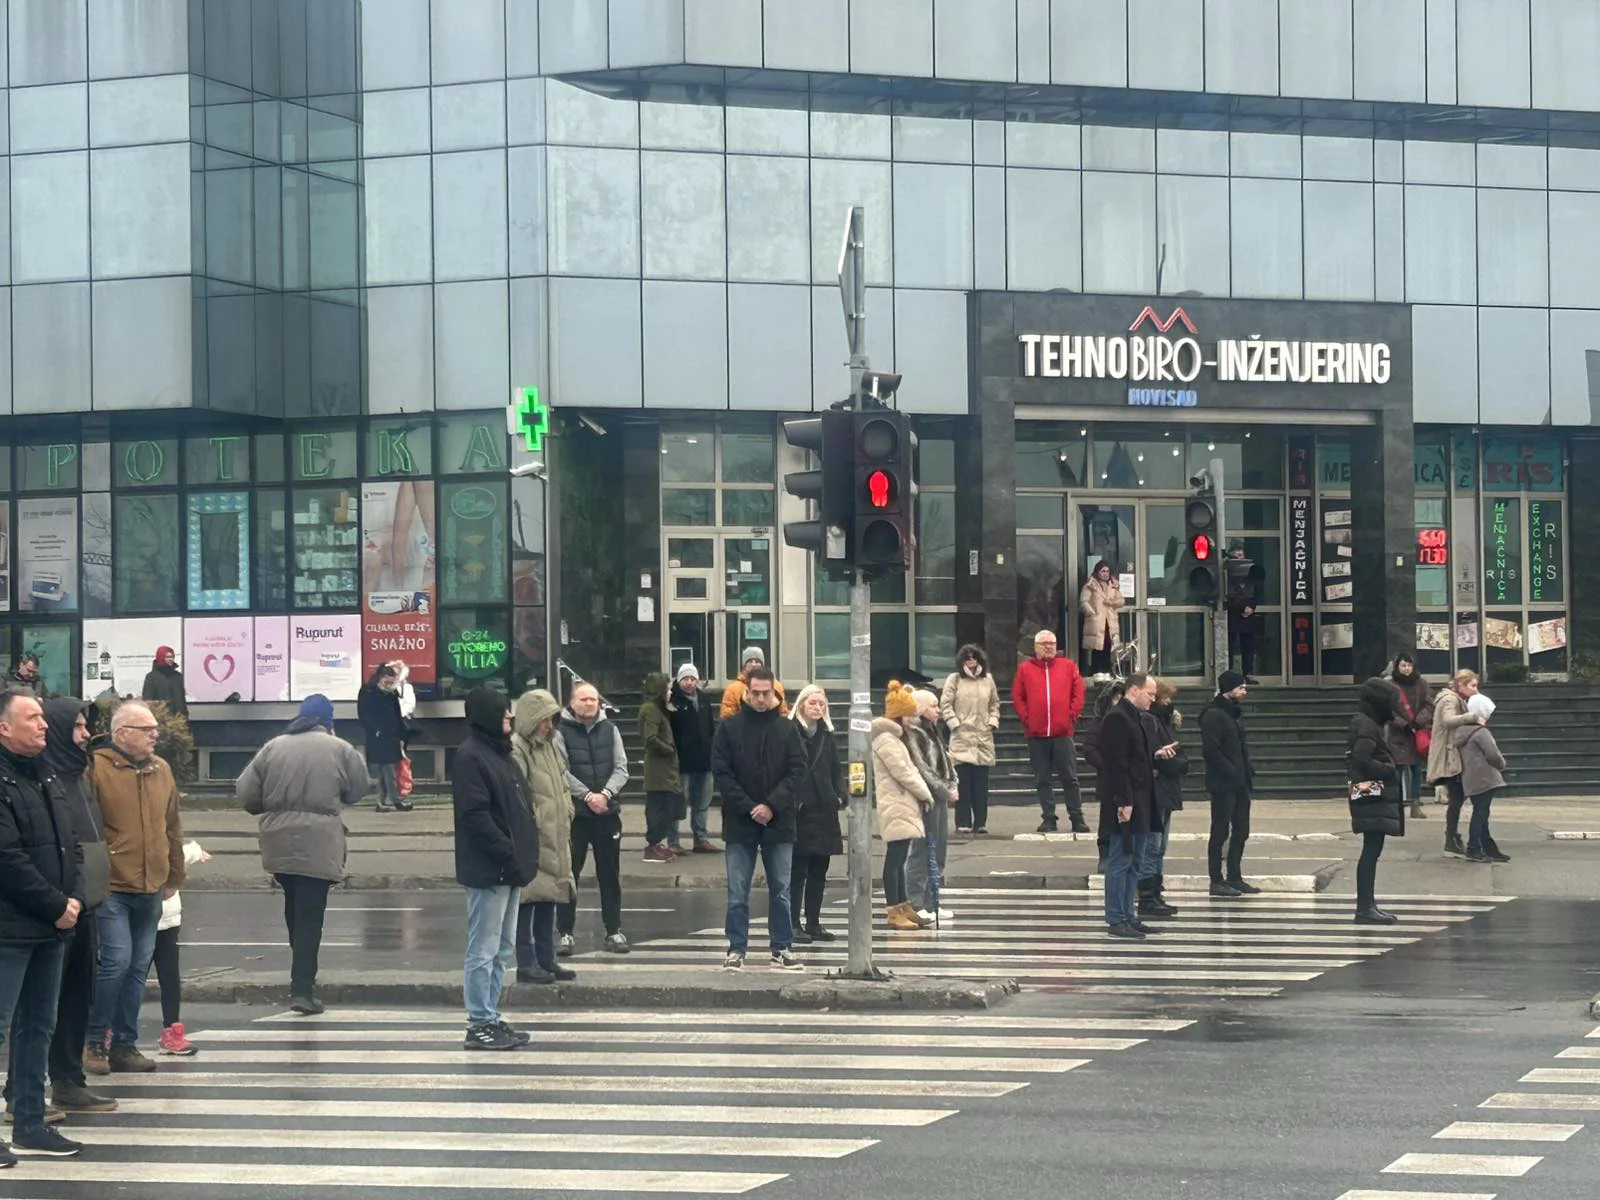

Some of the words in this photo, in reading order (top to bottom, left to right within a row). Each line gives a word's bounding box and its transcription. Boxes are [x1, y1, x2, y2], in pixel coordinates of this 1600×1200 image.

[1532, 503, 1542, 600] EXCHANGE
[371, 635, 426, 651] SNAŽNO
[453, 654, 498, 669] TILIA
